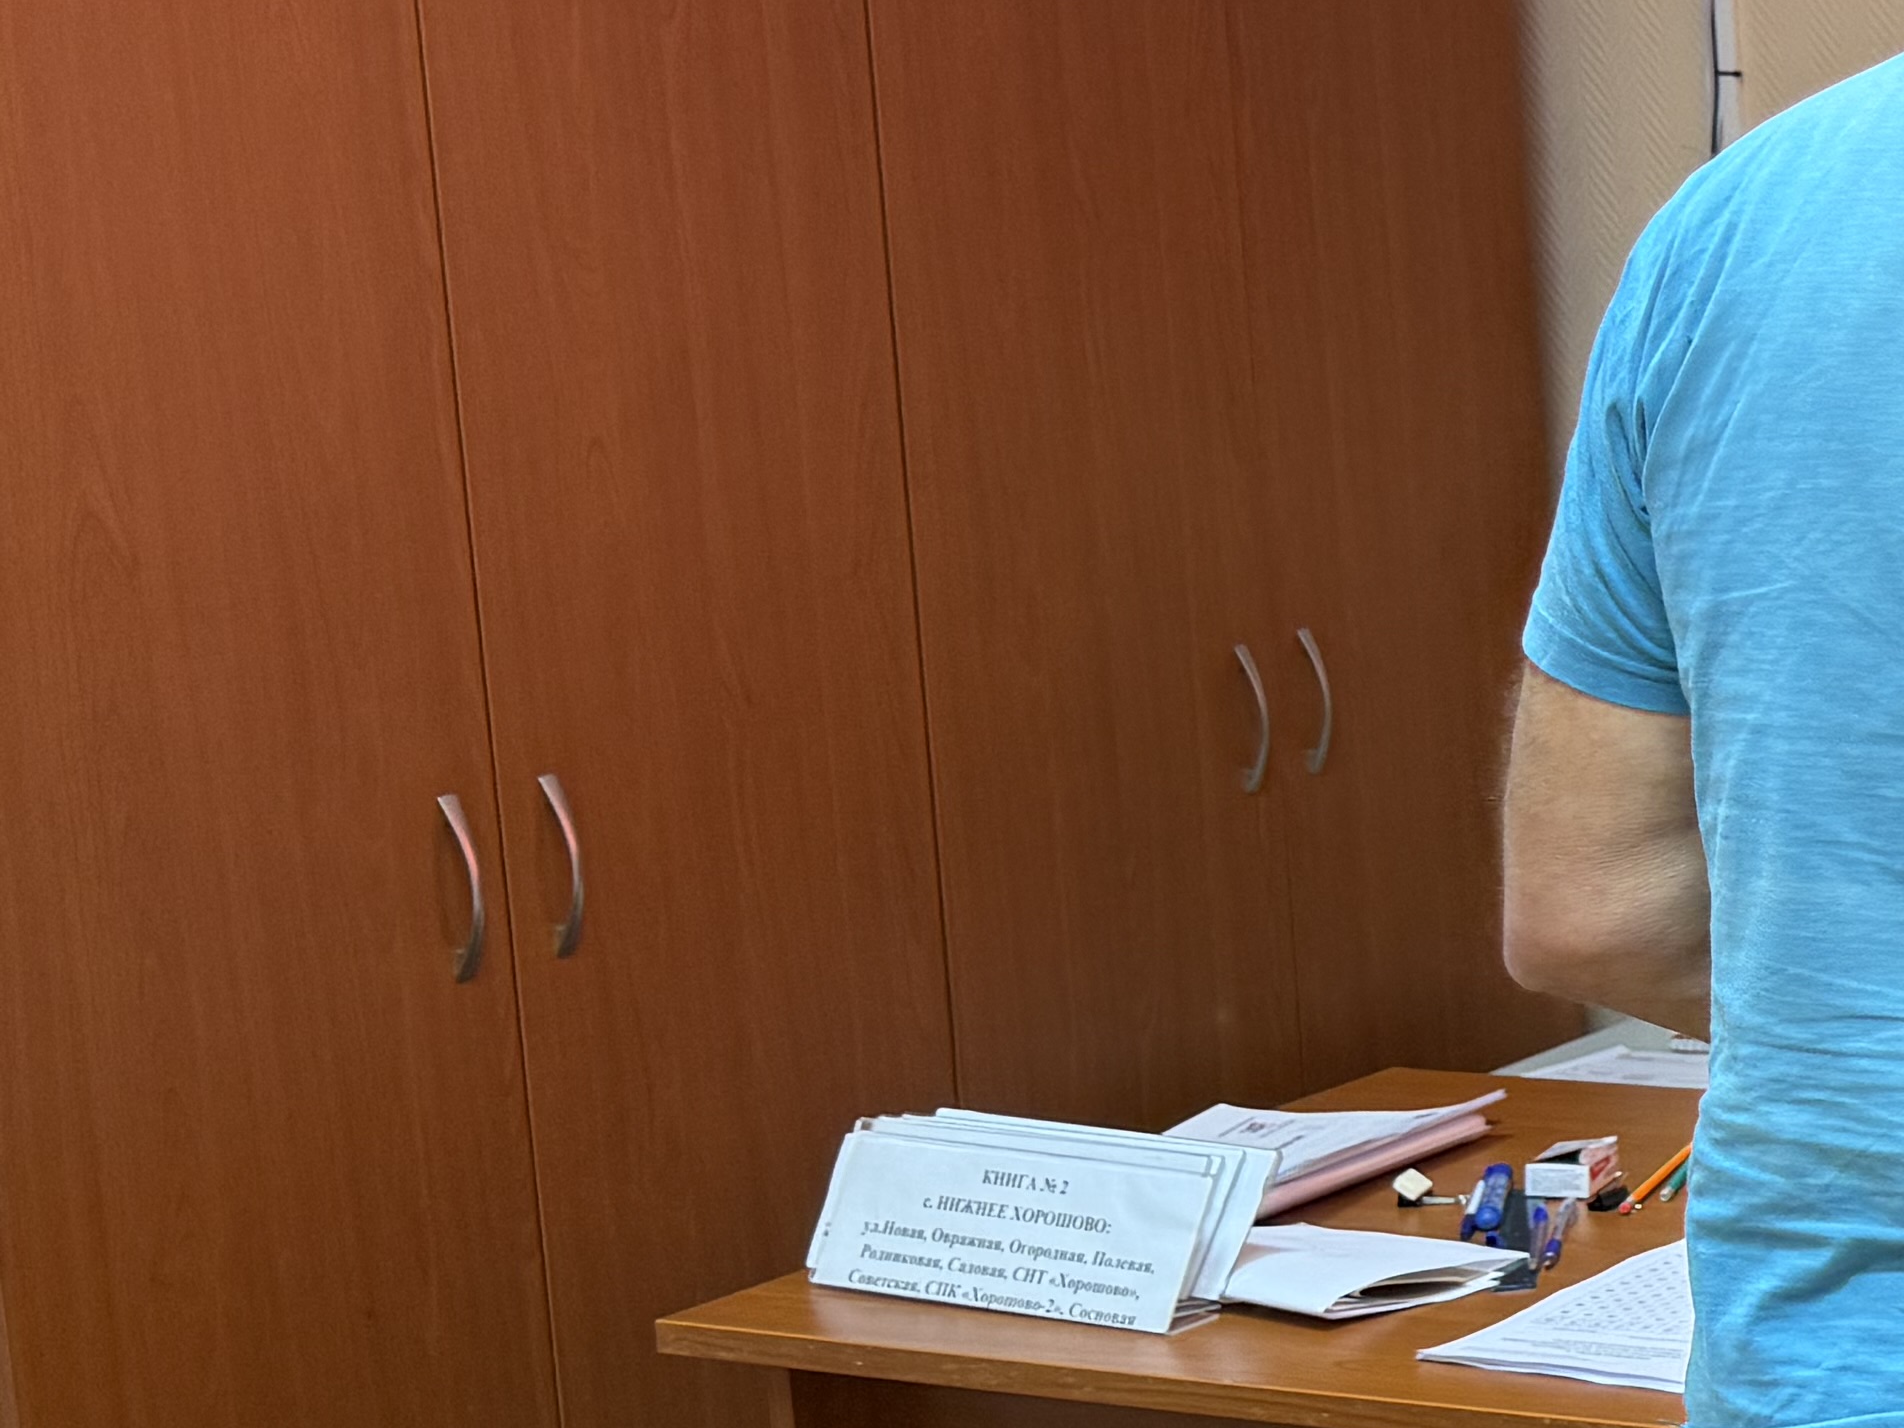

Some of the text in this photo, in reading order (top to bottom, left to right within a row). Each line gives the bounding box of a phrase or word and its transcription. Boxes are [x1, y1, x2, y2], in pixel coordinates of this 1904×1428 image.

[982, 1169, 1070, 1195] КНИГА № 2
[922, 1195, 1112, 1234] с. НИЖНЕЕ ХОРОШОВО:
[931, 1227, 1005, 1252] Овражная,
[1009, 1239, 1088, 1265] Огородная,
[1091, 1250, 1155, 1274] Полевая,
[947, 1256, 1007, 1280] Садовая,
[1012, 1266, 1049, 1285] СНТ
[847, 1268, 921, 1293] Советская,
[925, 1280, 962, 1299] СПК
[1068, 1302, 1137, 1326] Сосновая
